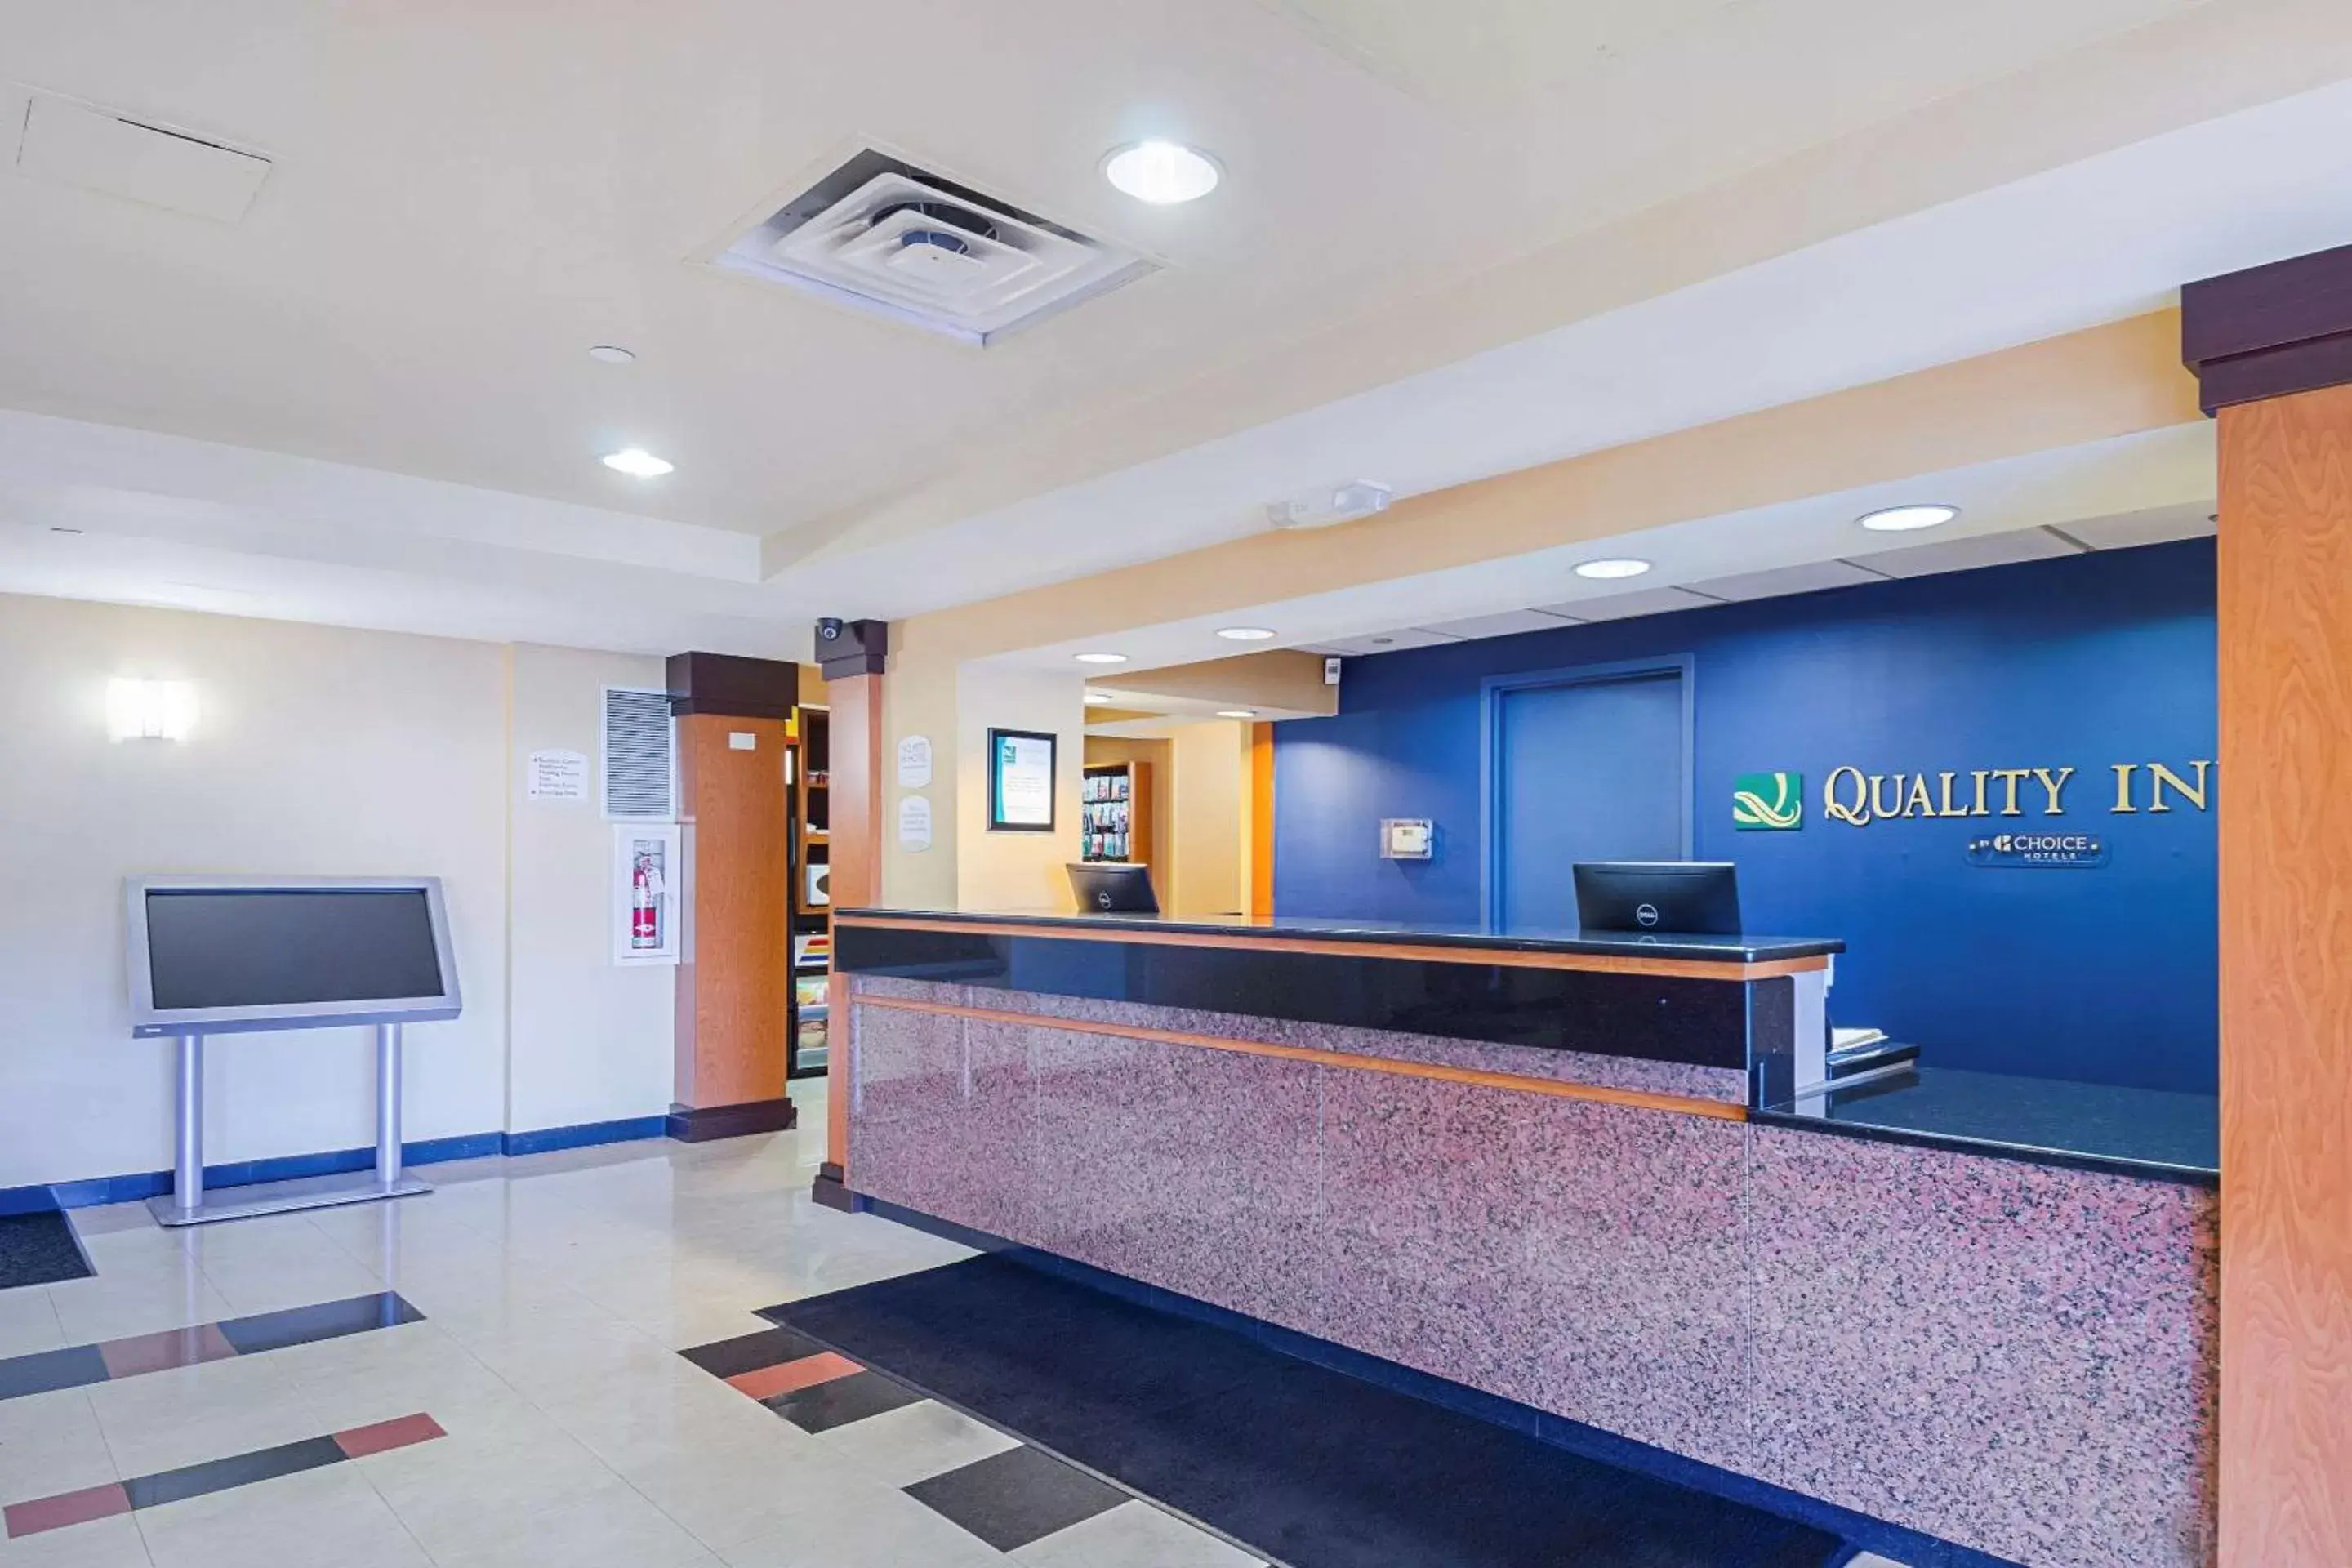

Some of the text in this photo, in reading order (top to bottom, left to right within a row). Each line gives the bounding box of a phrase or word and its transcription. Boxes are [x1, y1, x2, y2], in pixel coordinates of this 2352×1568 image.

[1824, 760, 2219, 827] QUALITY IN
[2013, 835, 2087, 851] CHOICE
[2024, 852, 2078, 860] HOTELS
